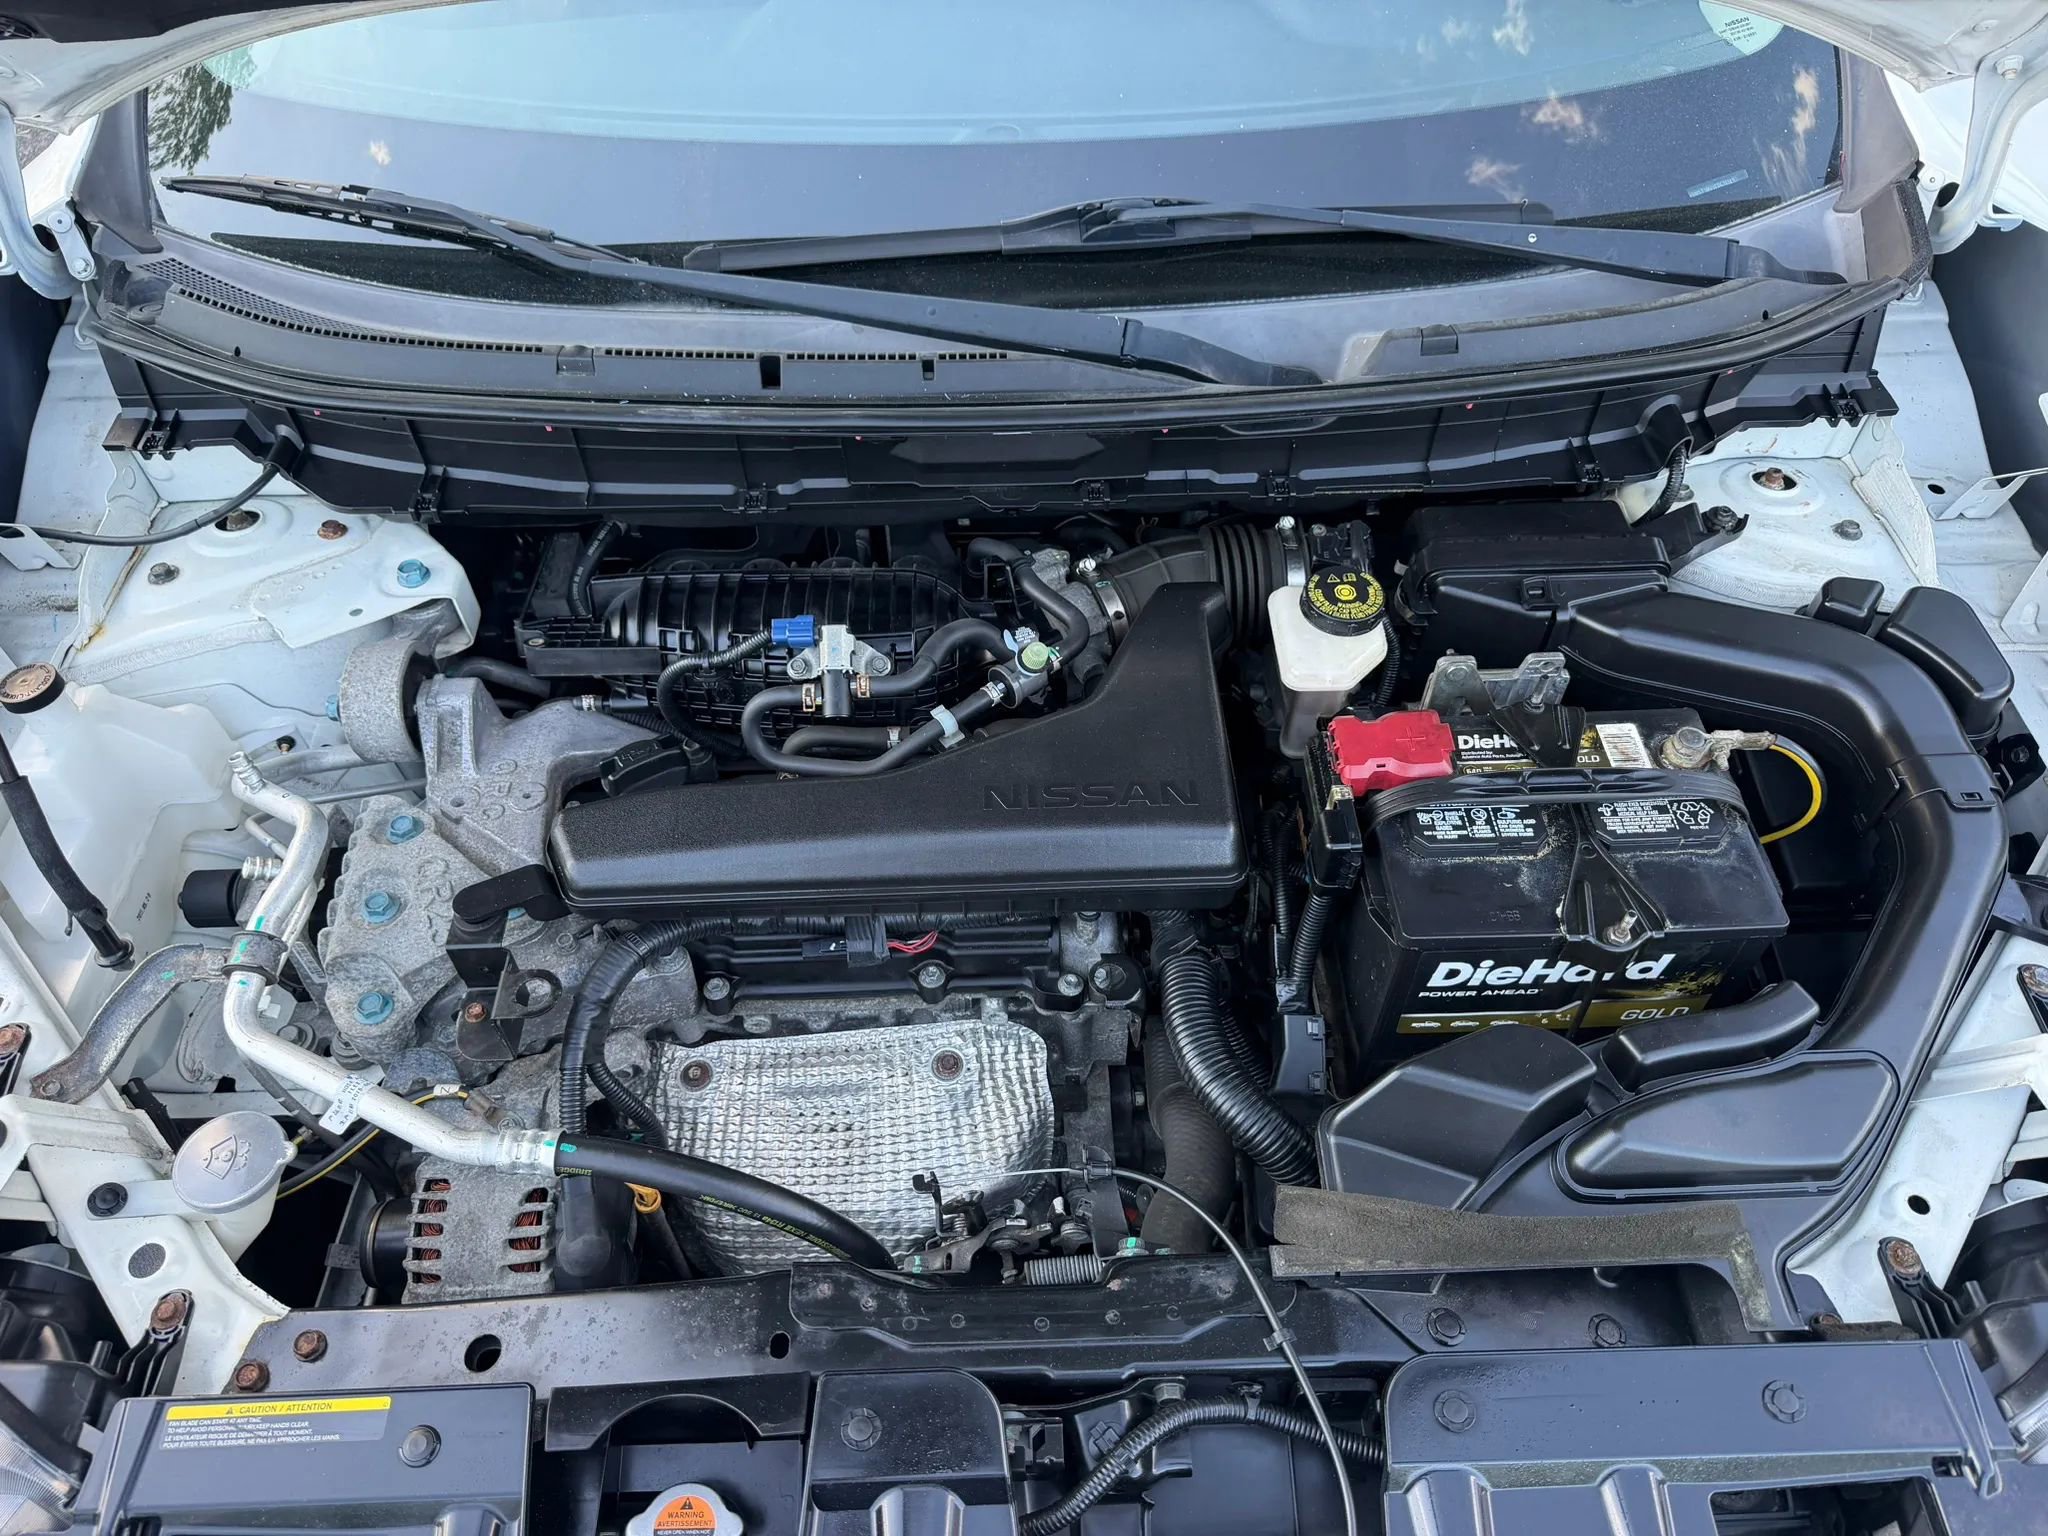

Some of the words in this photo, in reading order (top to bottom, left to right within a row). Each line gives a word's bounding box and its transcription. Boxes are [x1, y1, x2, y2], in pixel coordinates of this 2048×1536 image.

[1724, 16, 1750, 27] NISSAN
[1577, 755, 1600, 763] OLD
[984, 784, 1200, 810] NISSAN
[1426, 954, 1676, 988] DieHad
[1620, 1006, 1690, 1021] GOLD
[239, 1405, 277, 1414] CAUTION
[286, 1403, 332, 1412] ATTENTION
